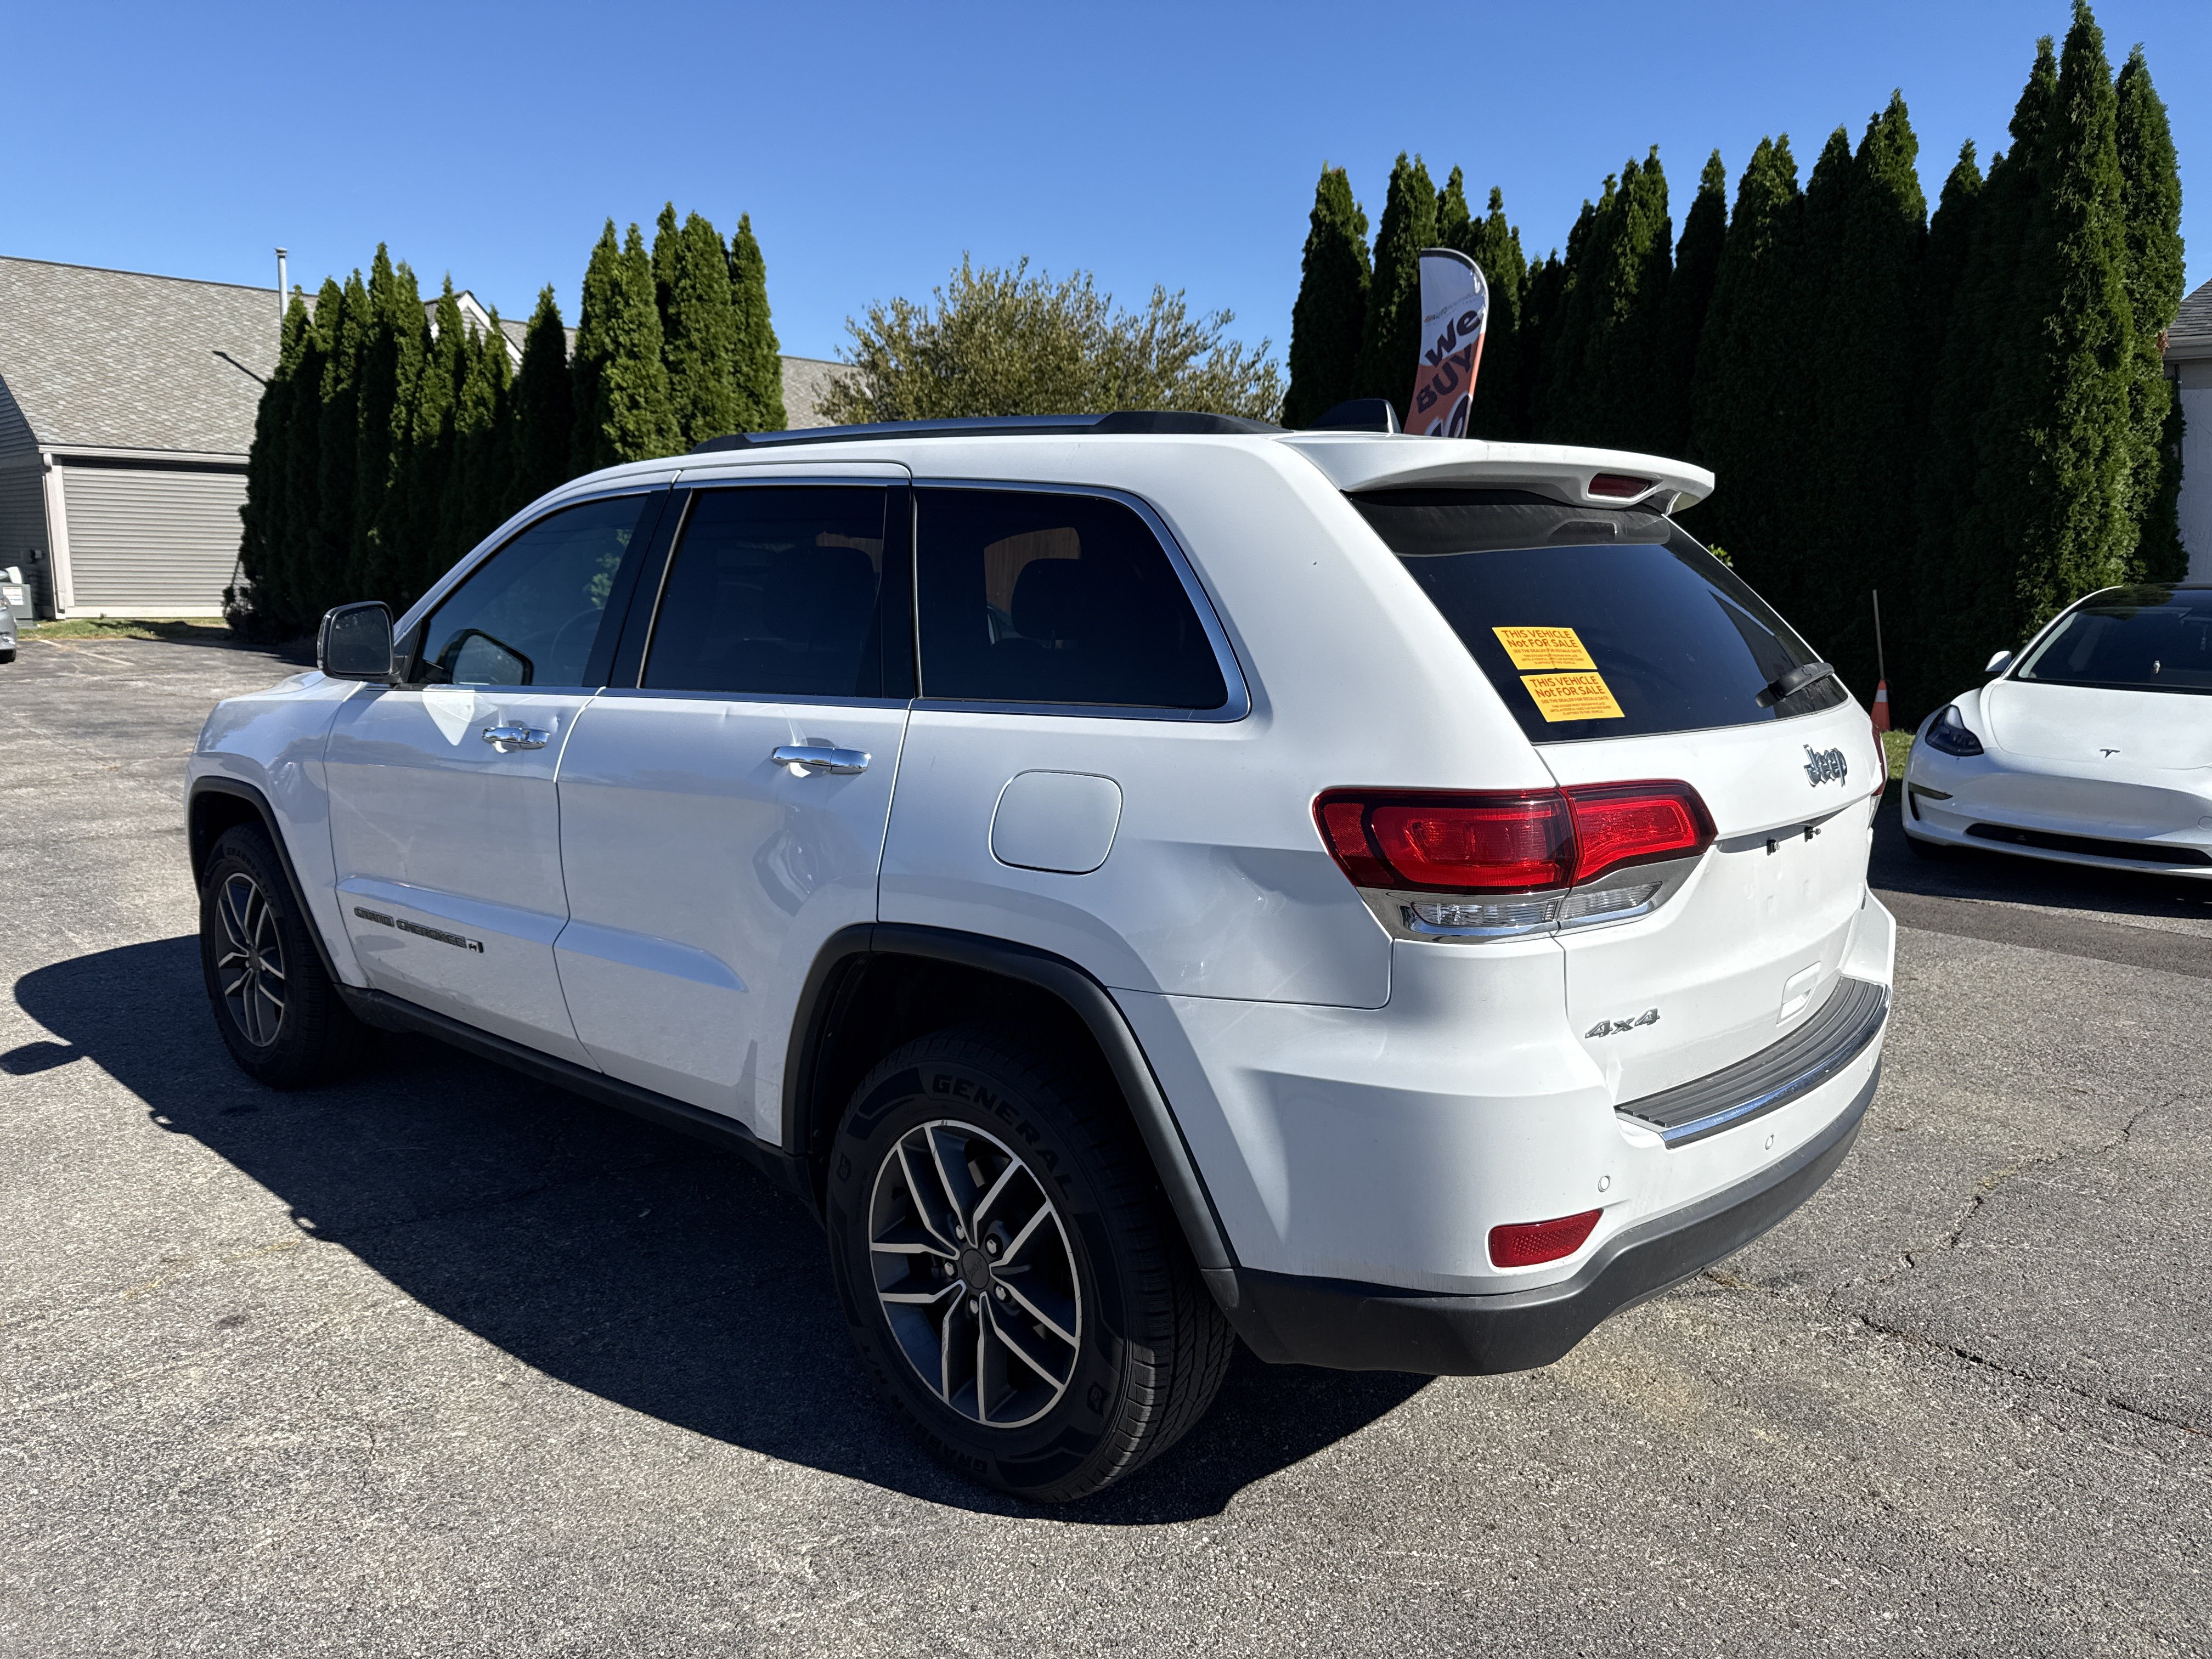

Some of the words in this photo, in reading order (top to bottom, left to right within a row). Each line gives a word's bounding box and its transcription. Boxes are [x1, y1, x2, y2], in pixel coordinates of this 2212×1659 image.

[1416, 342, 1472, 414] BUY
[1501, 630, 1528, 639] THIS
[1530, 630, 1572, 639] VEHICLE
[1506, 639, 1527, 648] Not
[1528, 639, 1550, 648] FOR
[1550, 639, 1579, 648] SALE
[1529, 678, 1556, 688] THIS
[1554, 675, 1599, 686] VEHICLE
[1534, 687, 1558, 698] Not
[1558, 686, 1579, 697] FOR
[1581, 685, 1606, 695] SALE
[1803, 744, 1848, 787] Jeep
[1584, 1007, 1661, 1039] 4x4
[932, 1073, 1072, 1201] GENERAL
